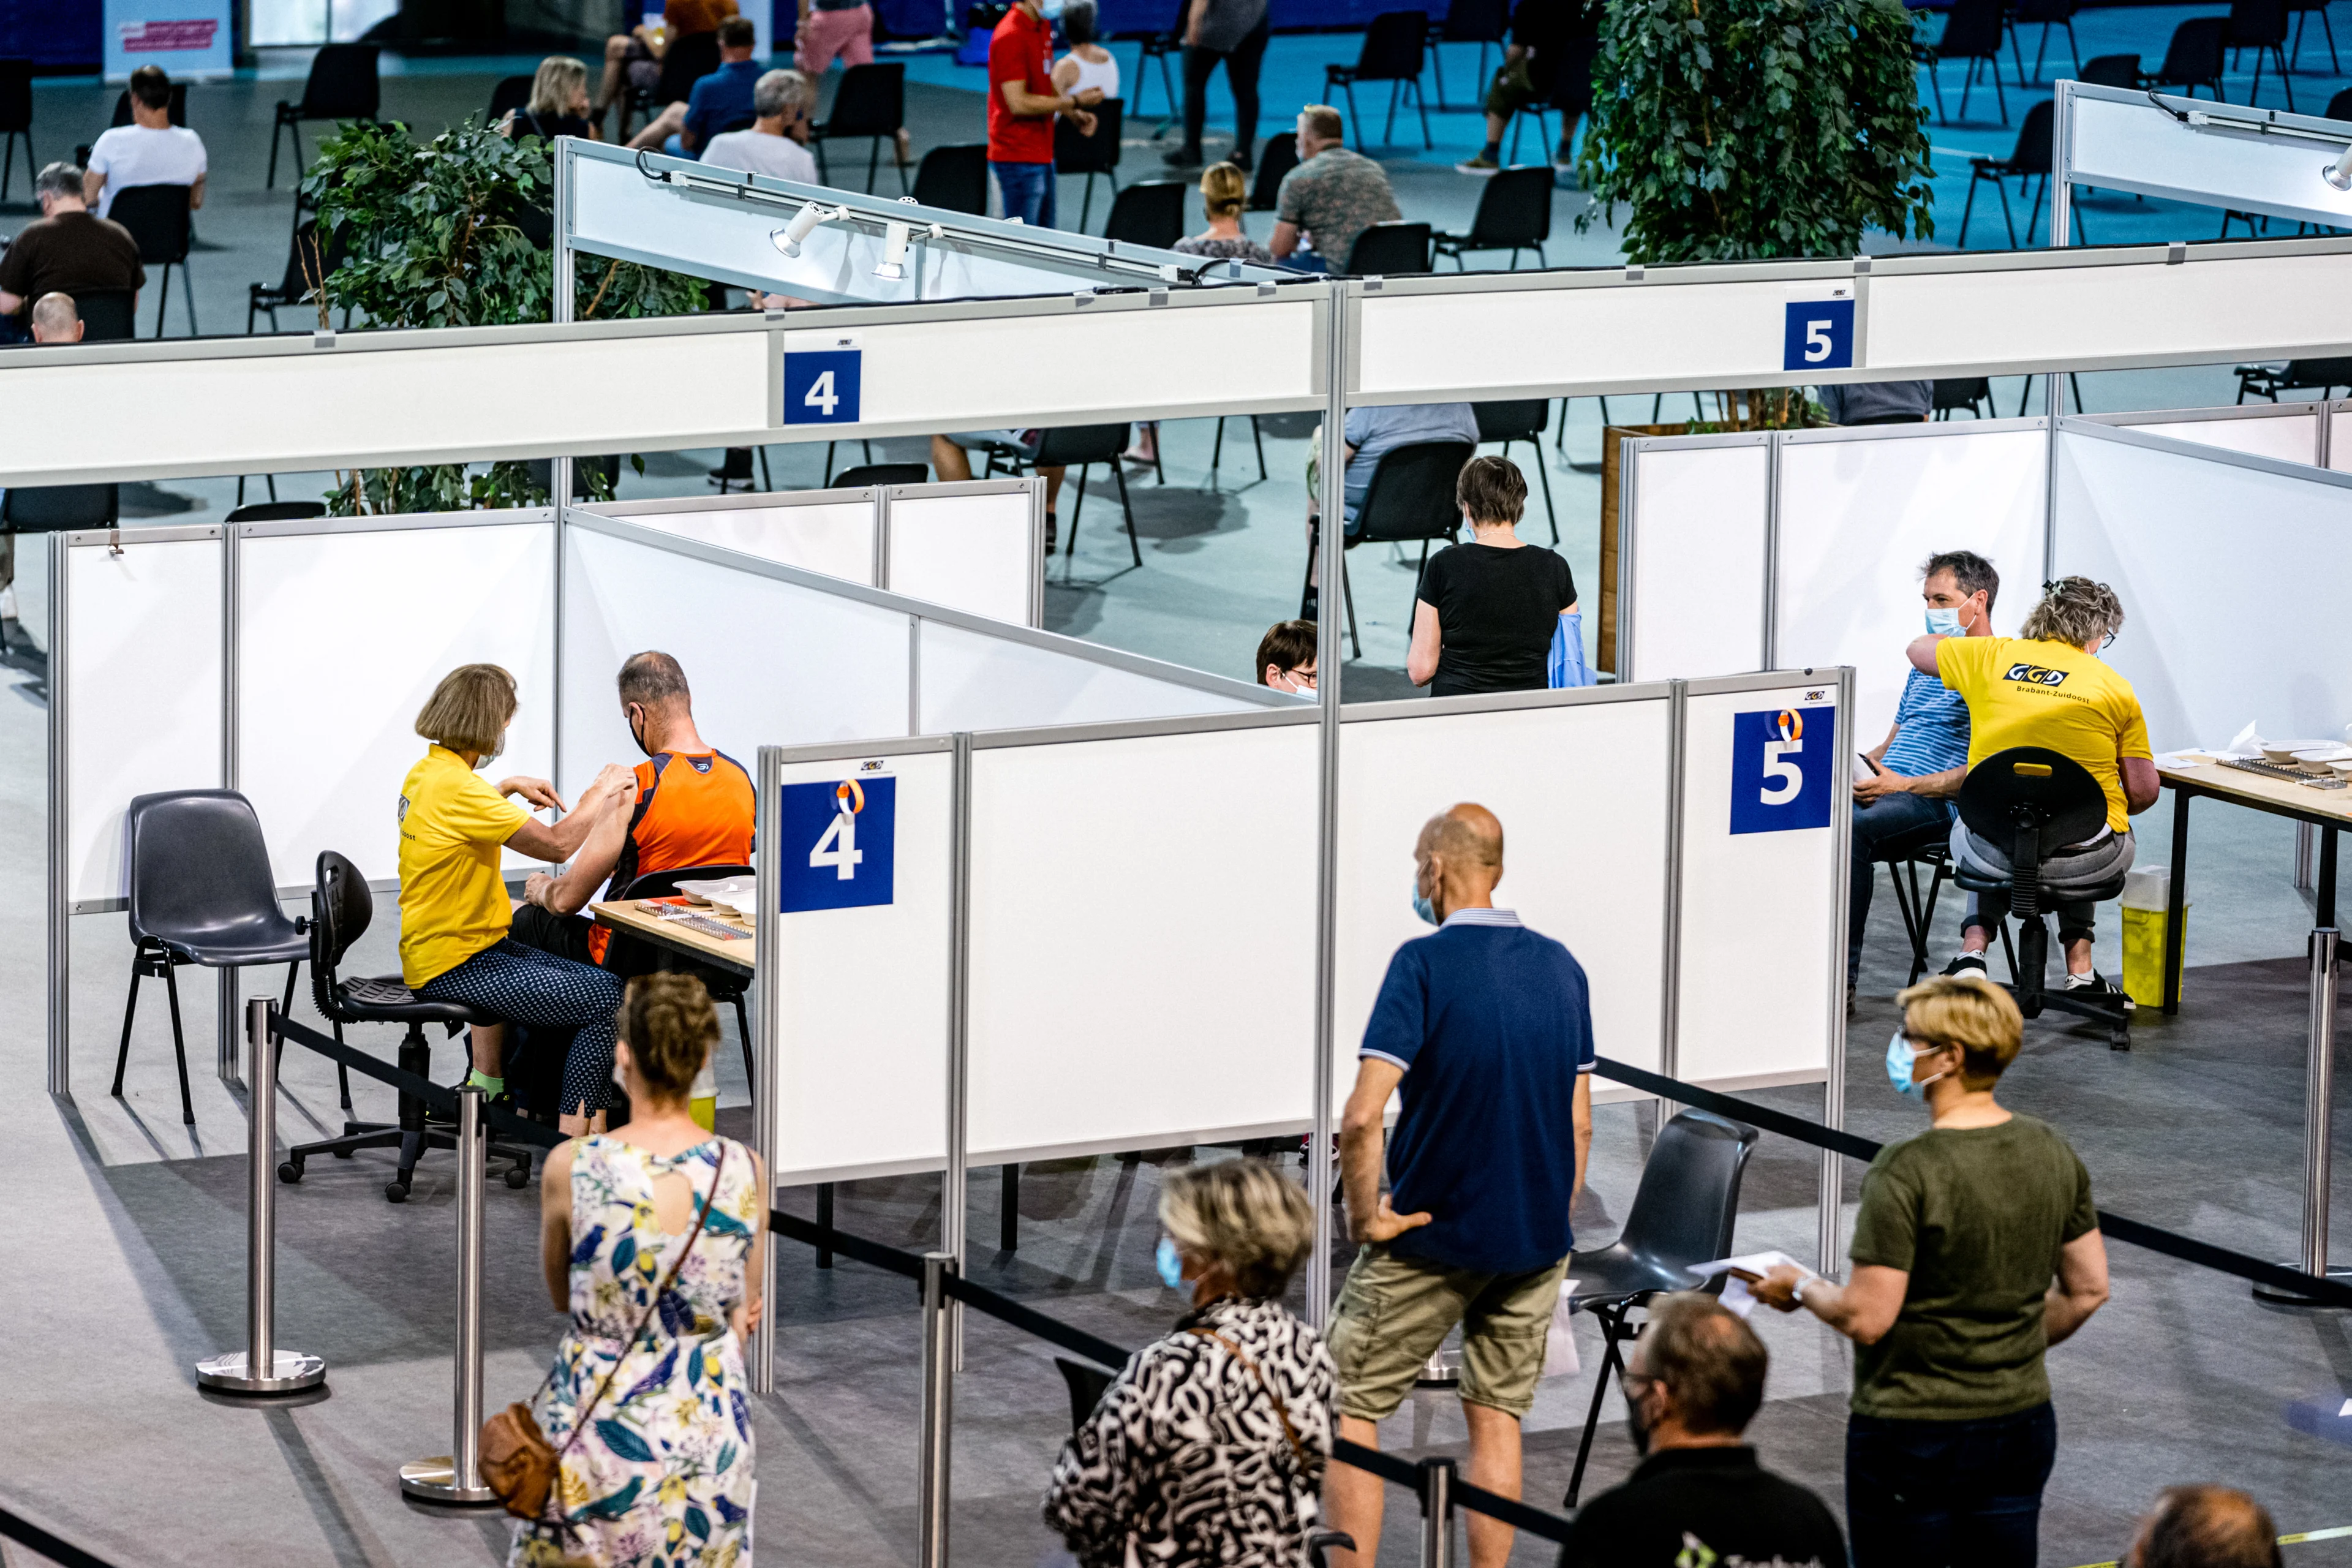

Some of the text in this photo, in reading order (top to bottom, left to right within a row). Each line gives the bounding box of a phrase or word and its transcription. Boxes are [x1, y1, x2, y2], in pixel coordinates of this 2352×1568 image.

[1804, 320, 1832, 362] 5
[804, 371, 839, 415] 4
[2007, 665, 2065, 685] GGD
[1805, 691, 1824, 700] GGD
[2016, 685, 2090, 704] Brabant-Zuidoost
[861, 761, 883, 770] GGD
[1760, 739, 1803, 805] 5
[809, 812, 863, 880] 4
